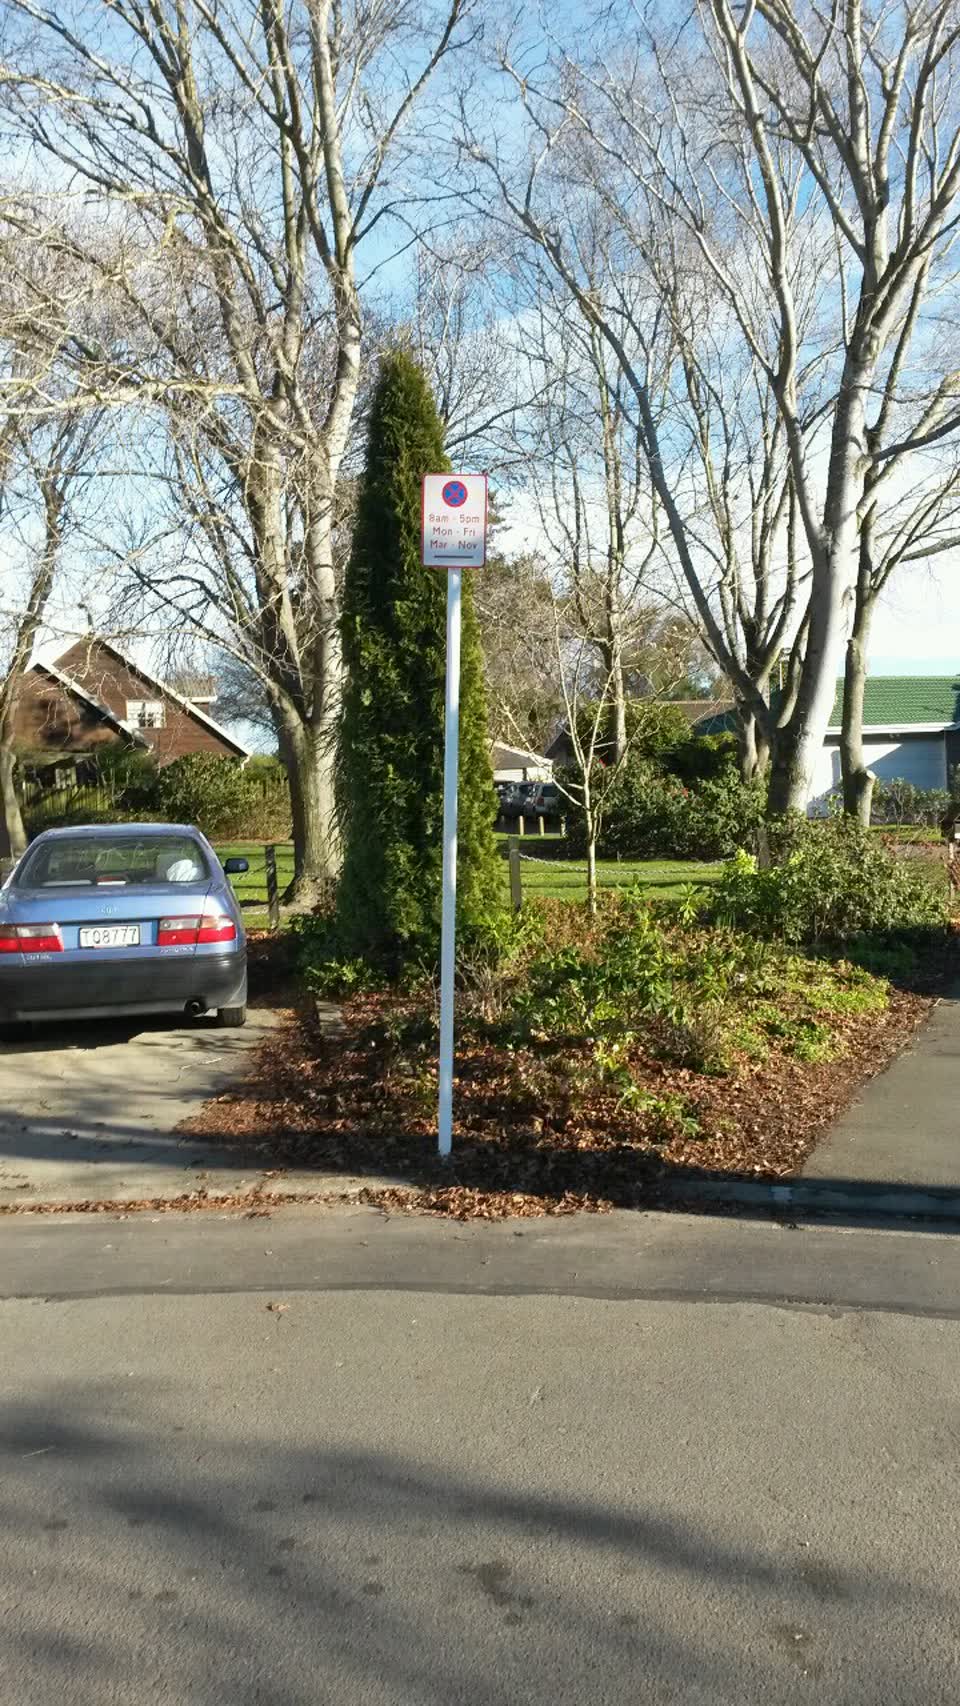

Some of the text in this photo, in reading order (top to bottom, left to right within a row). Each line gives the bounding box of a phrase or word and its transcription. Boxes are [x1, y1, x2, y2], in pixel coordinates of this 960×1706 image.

[428, 514, 449, 523] 8am
[459, 514, 480, 524] 5pm
[432, 526, 453, 536] Mon
[463, 527, 476, 537] Fri
[430, 539, 448, 550] Mar
[458, 540, 478, 550] Nov
